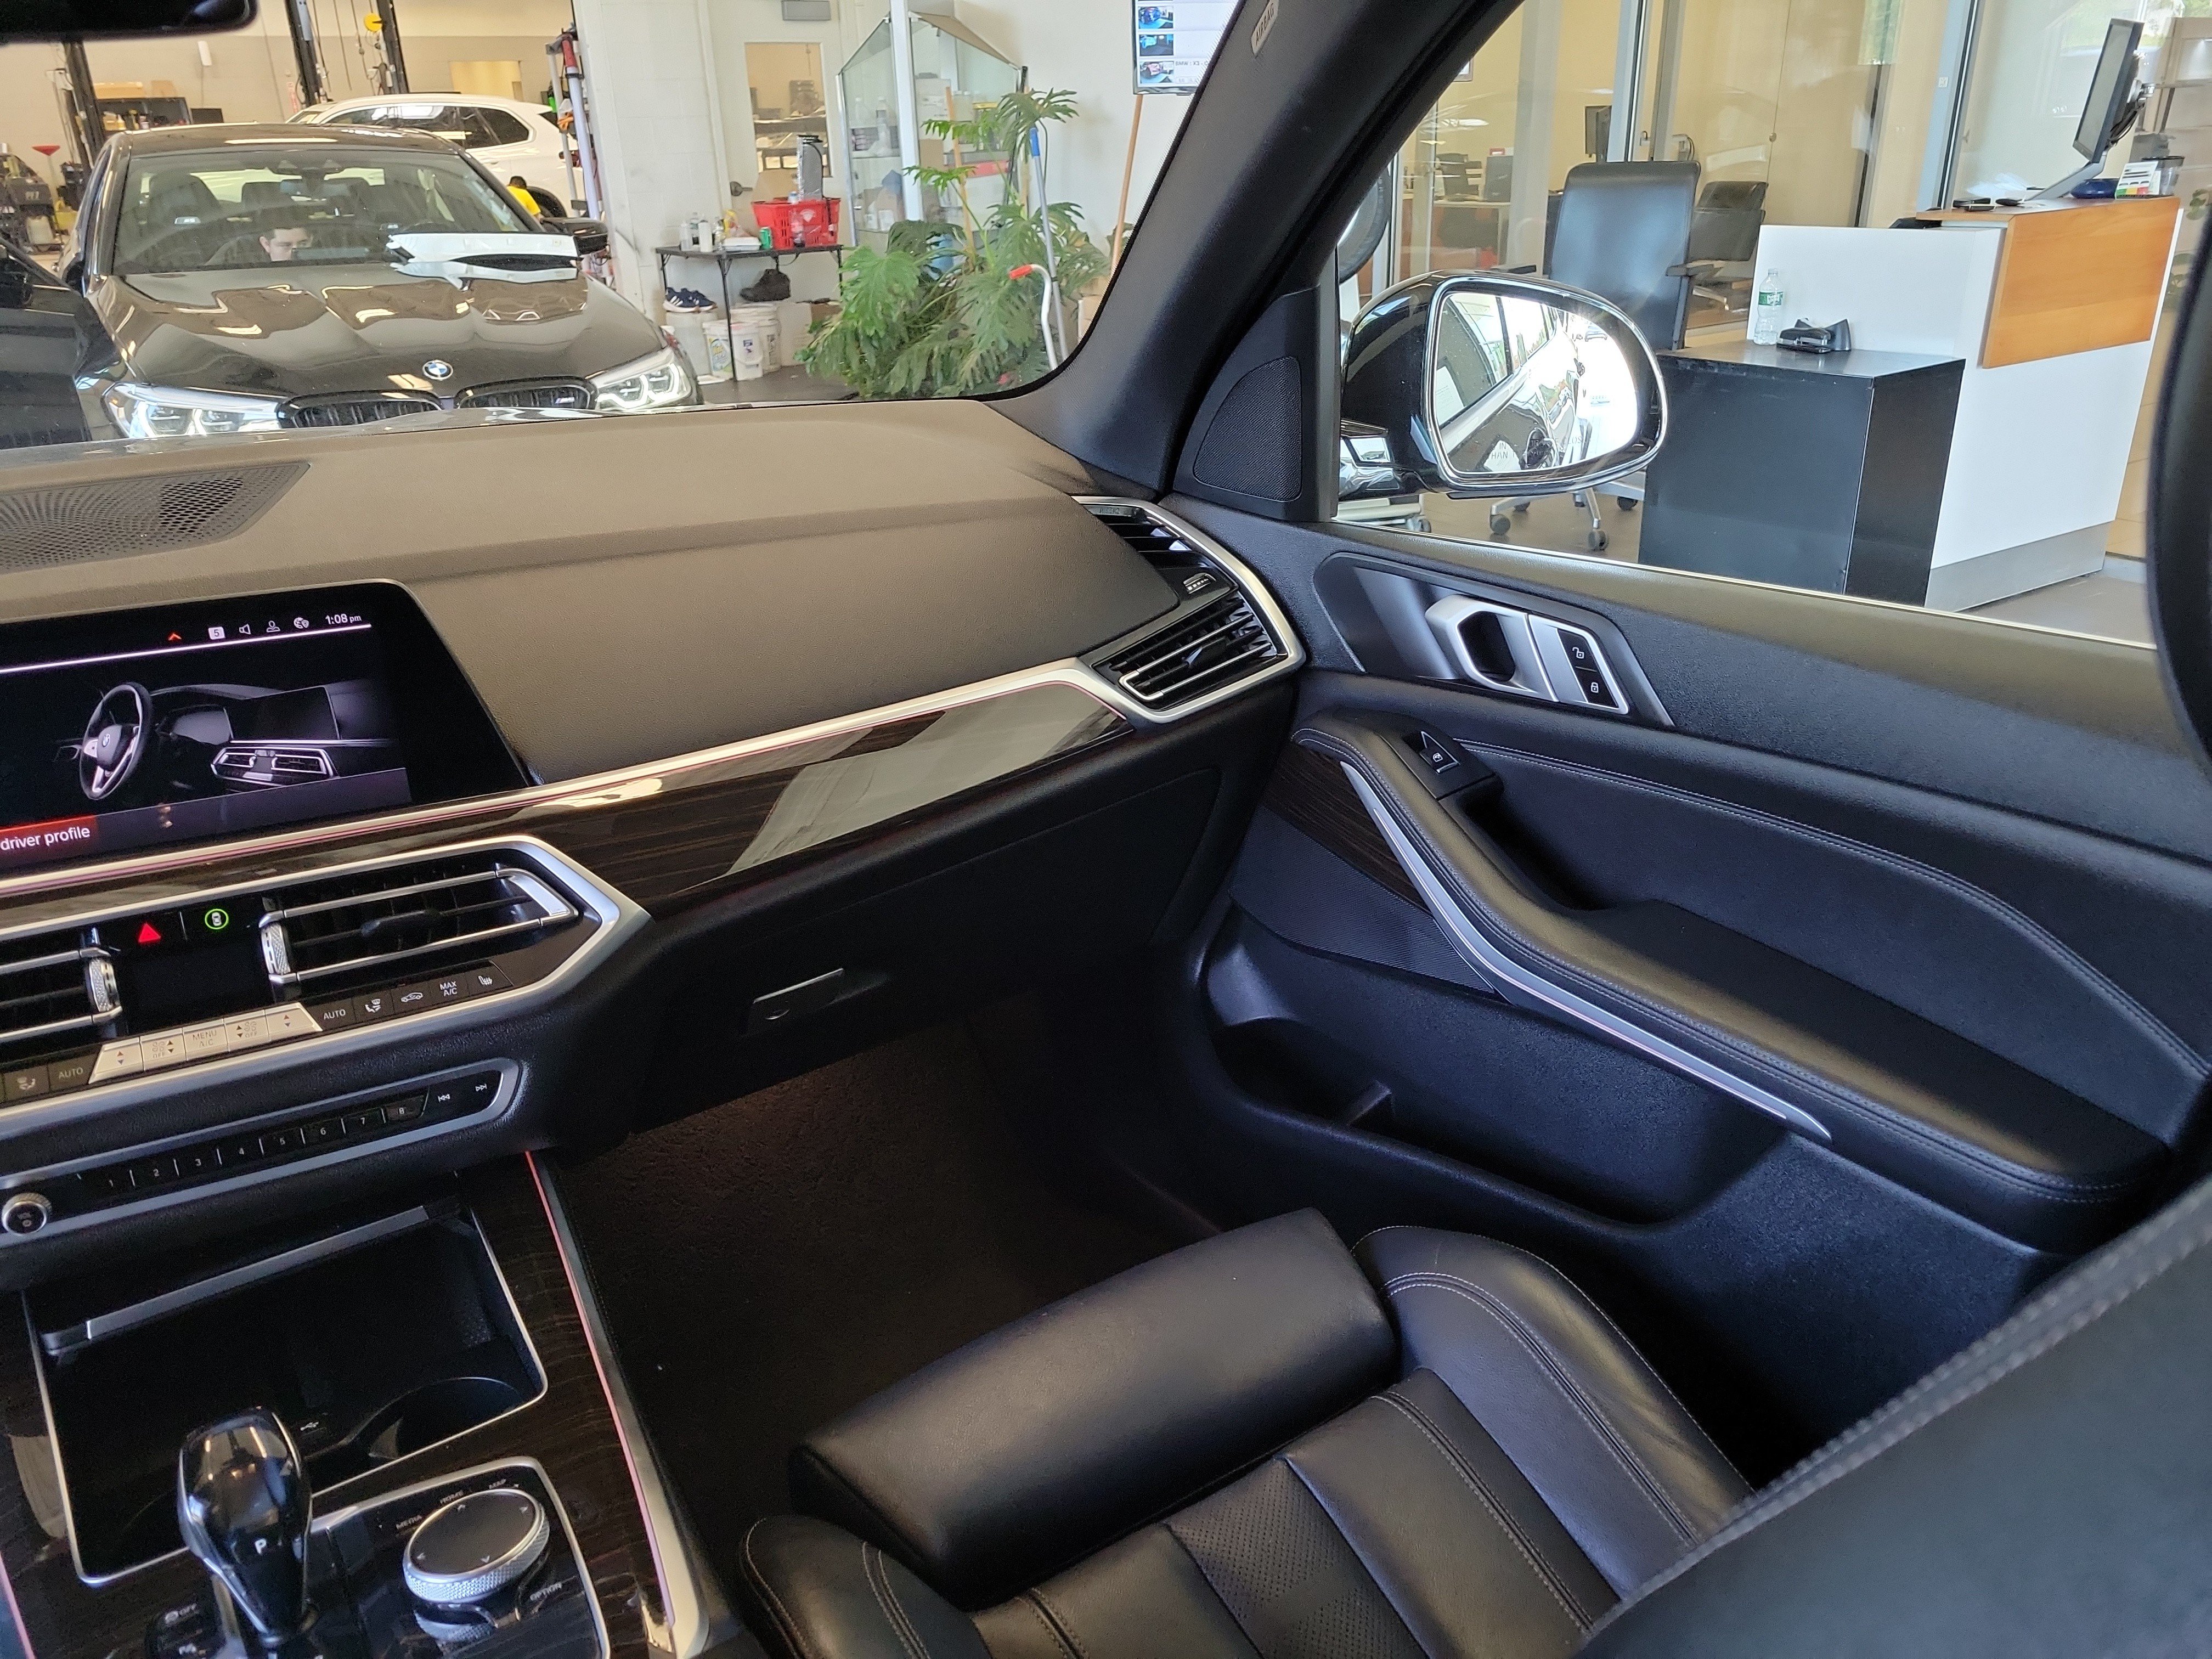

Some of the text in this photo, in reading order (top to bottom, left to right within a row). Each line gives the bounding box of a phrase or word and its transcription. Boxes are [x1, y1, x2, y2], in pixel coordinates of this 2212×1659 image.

[1256, 3, 1274, 46] AIRBAG
[325, 613, 362, 625] 1:08 pm
[0, 826, 91, 850] driver profile
[439, 981, 457, 991] MAX
[443, 988, 458, 997] A/C
[323, 1009, 346, 1020] AUTO
[193, 1030, 217, 1040] MENU
[59, 1067, 83, 1079] AUTO
[153, 1169, 160, 1177] 2
[255, 1538, 267, 1554] P
